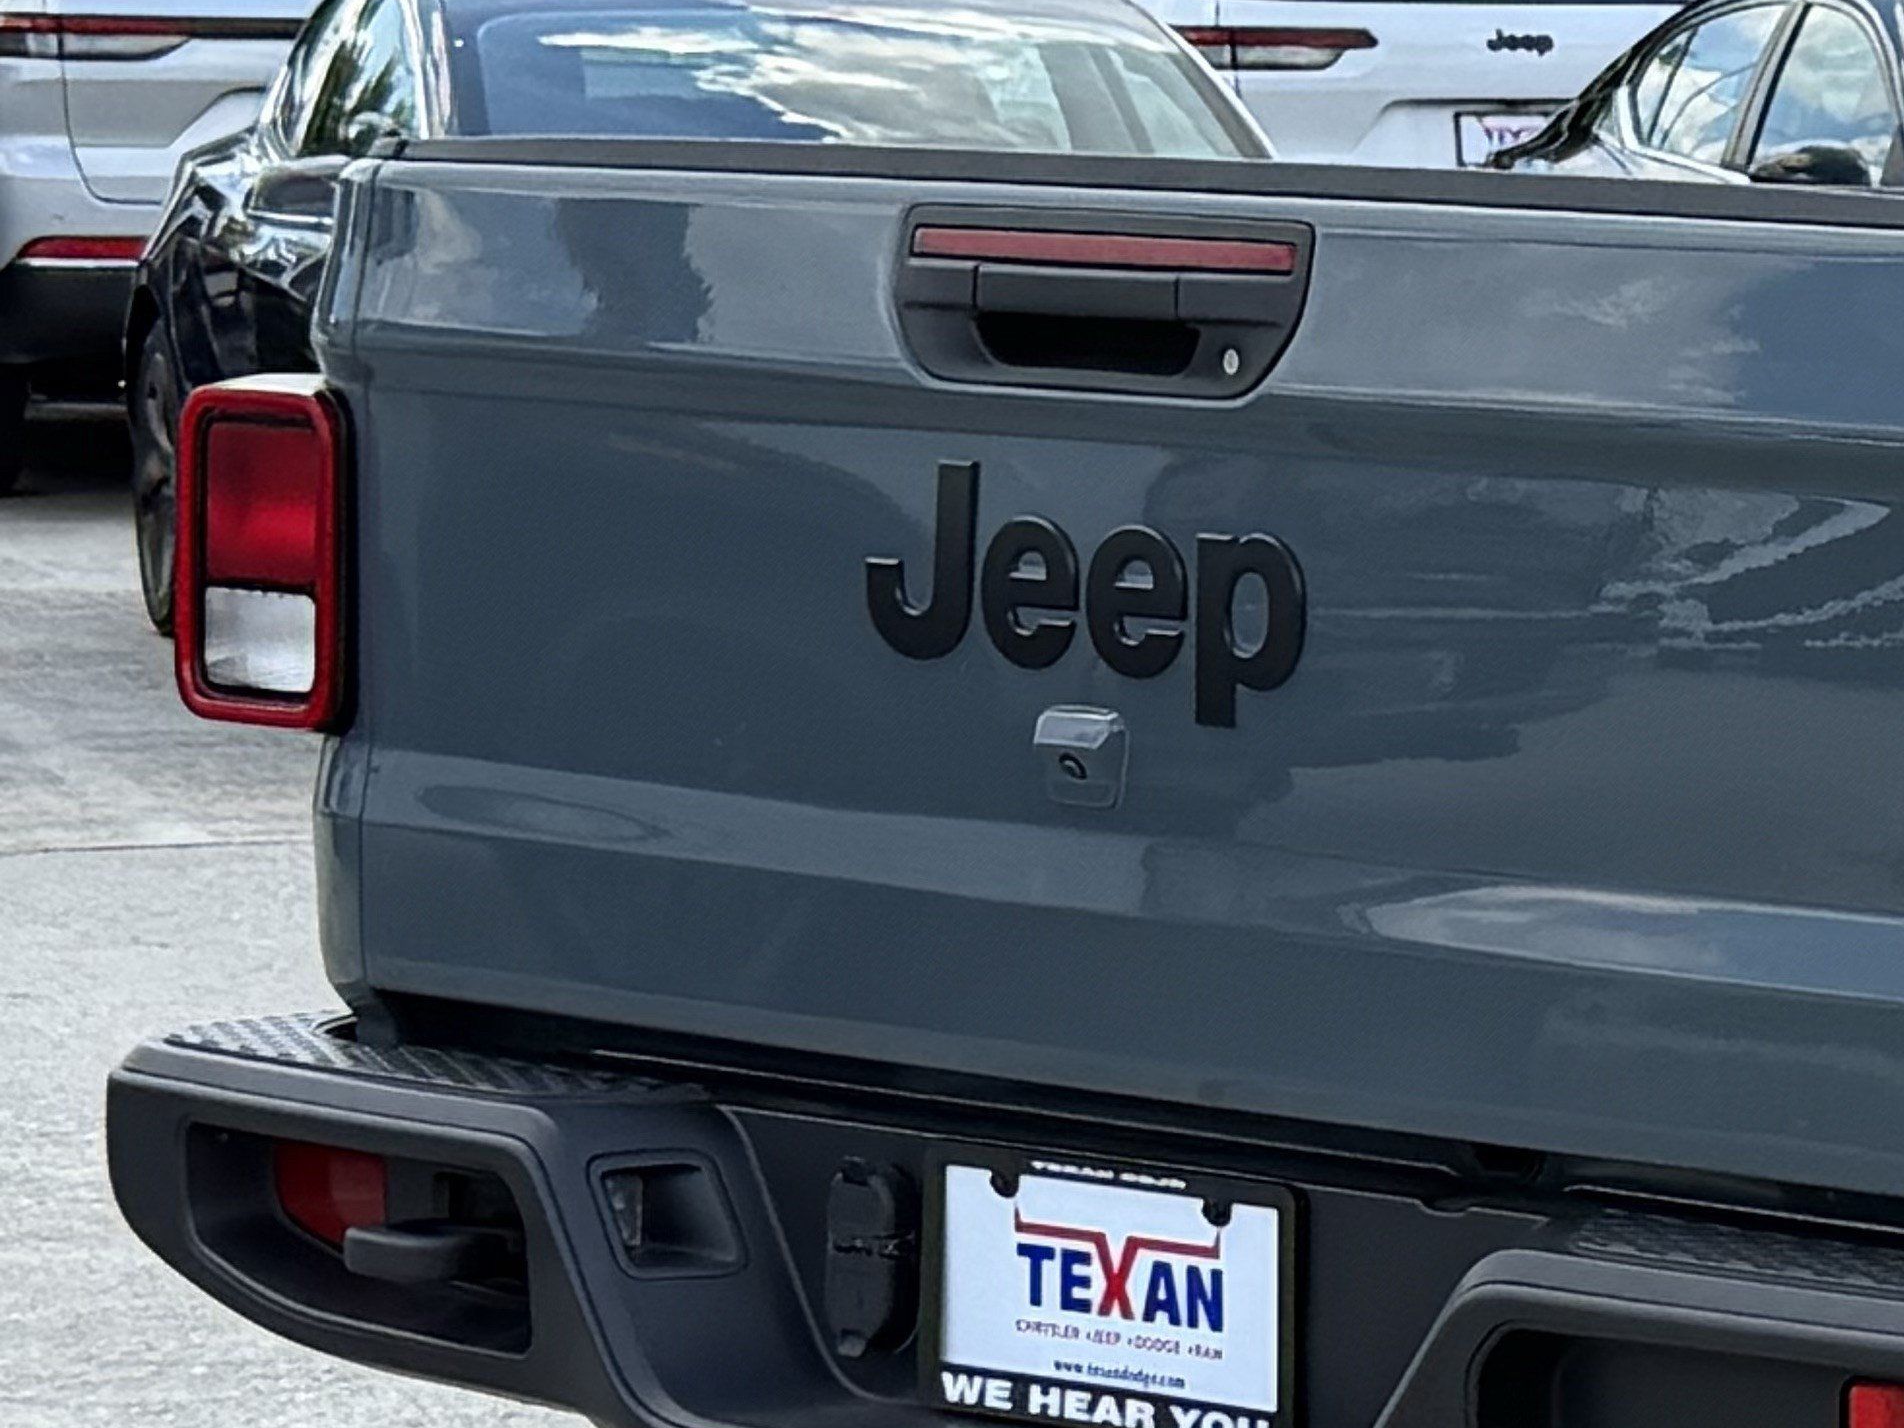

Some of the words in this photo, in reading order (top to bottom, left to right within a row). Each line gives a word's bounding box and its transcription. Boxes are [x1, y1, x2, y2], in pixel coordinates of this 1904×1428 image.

[1486, 28, 1554, 57] Jeep
[865, 460, 1307, 729] Jeep
[1014, 1206, 1224, 1333] TEXAN
[941, 1371, 1013, 1411] WE
